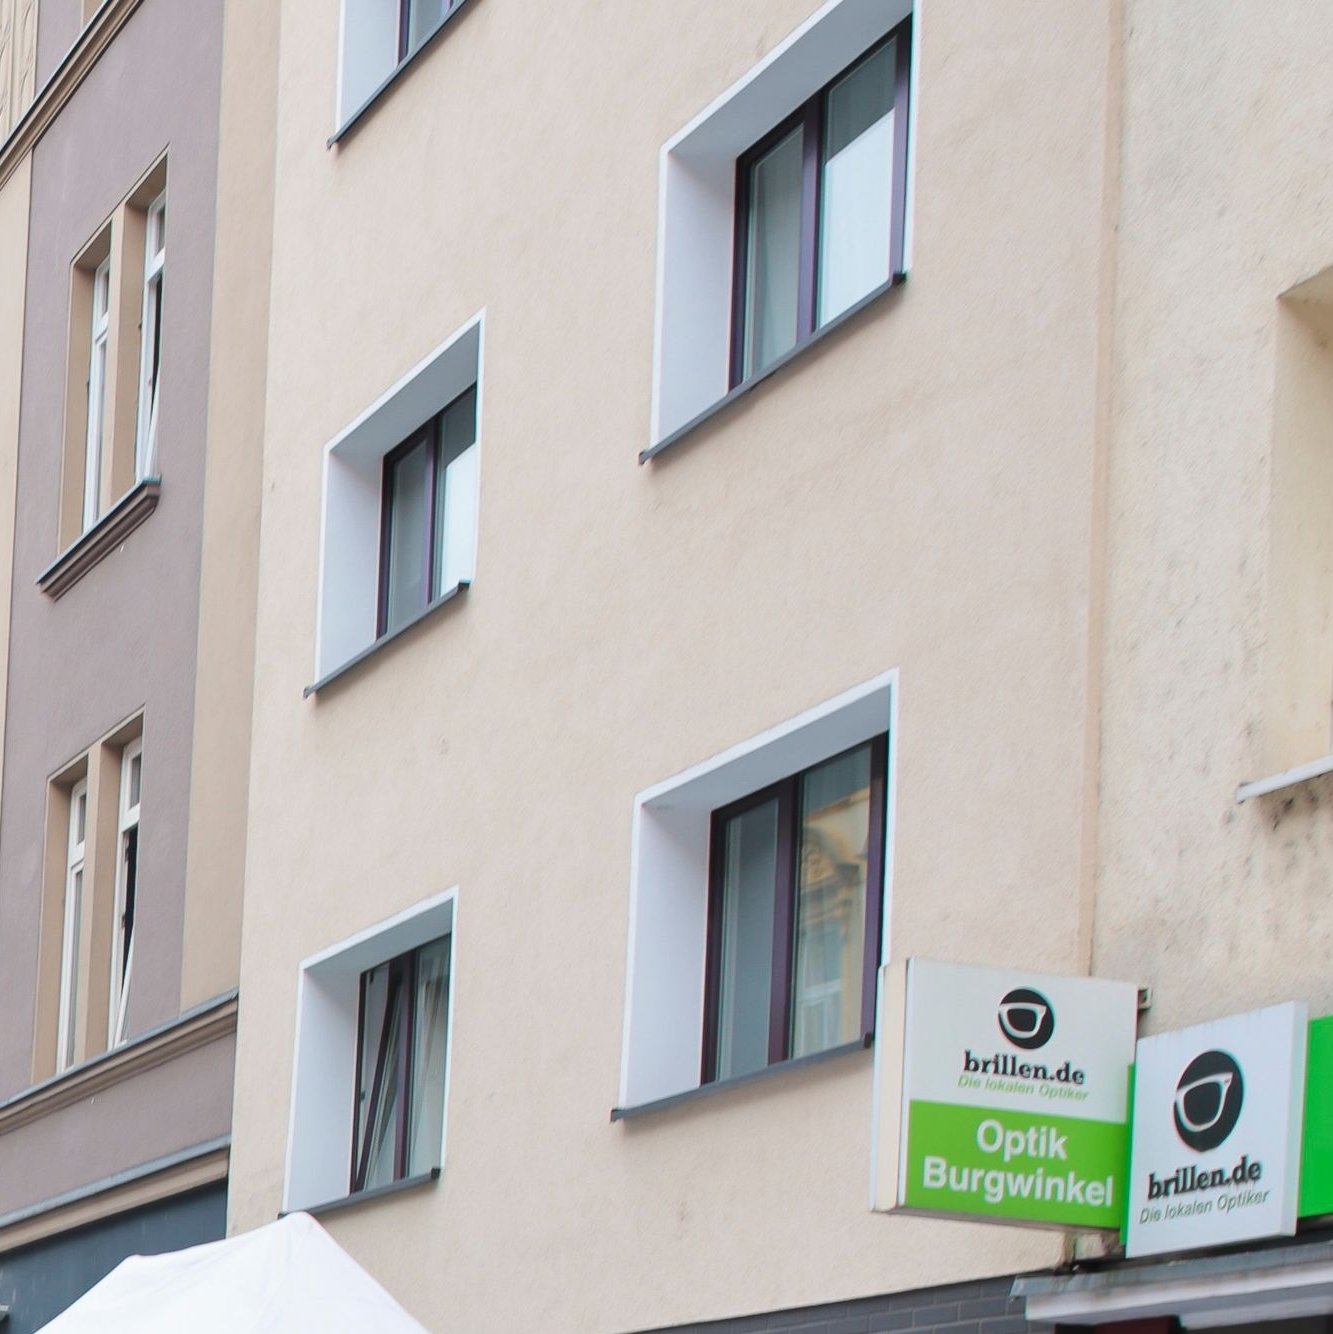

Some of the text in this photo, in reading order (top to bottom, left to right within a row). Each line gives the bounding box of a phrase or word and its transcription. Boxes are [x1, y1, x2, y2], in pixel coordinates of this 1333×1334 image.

[957, 1074, 1089, 1100] Die lokalen Optiker
[963, 1050, 1084, 1085] brillen.de
[976, 1118, 1068, 1162] Optik
[923, 1155, 1114, 1207] Burgwinkel
[1148, 1155, 1262, 1200] brillen.de
[1139, 1190, 1271, 1224] Die lokalen Optiker
